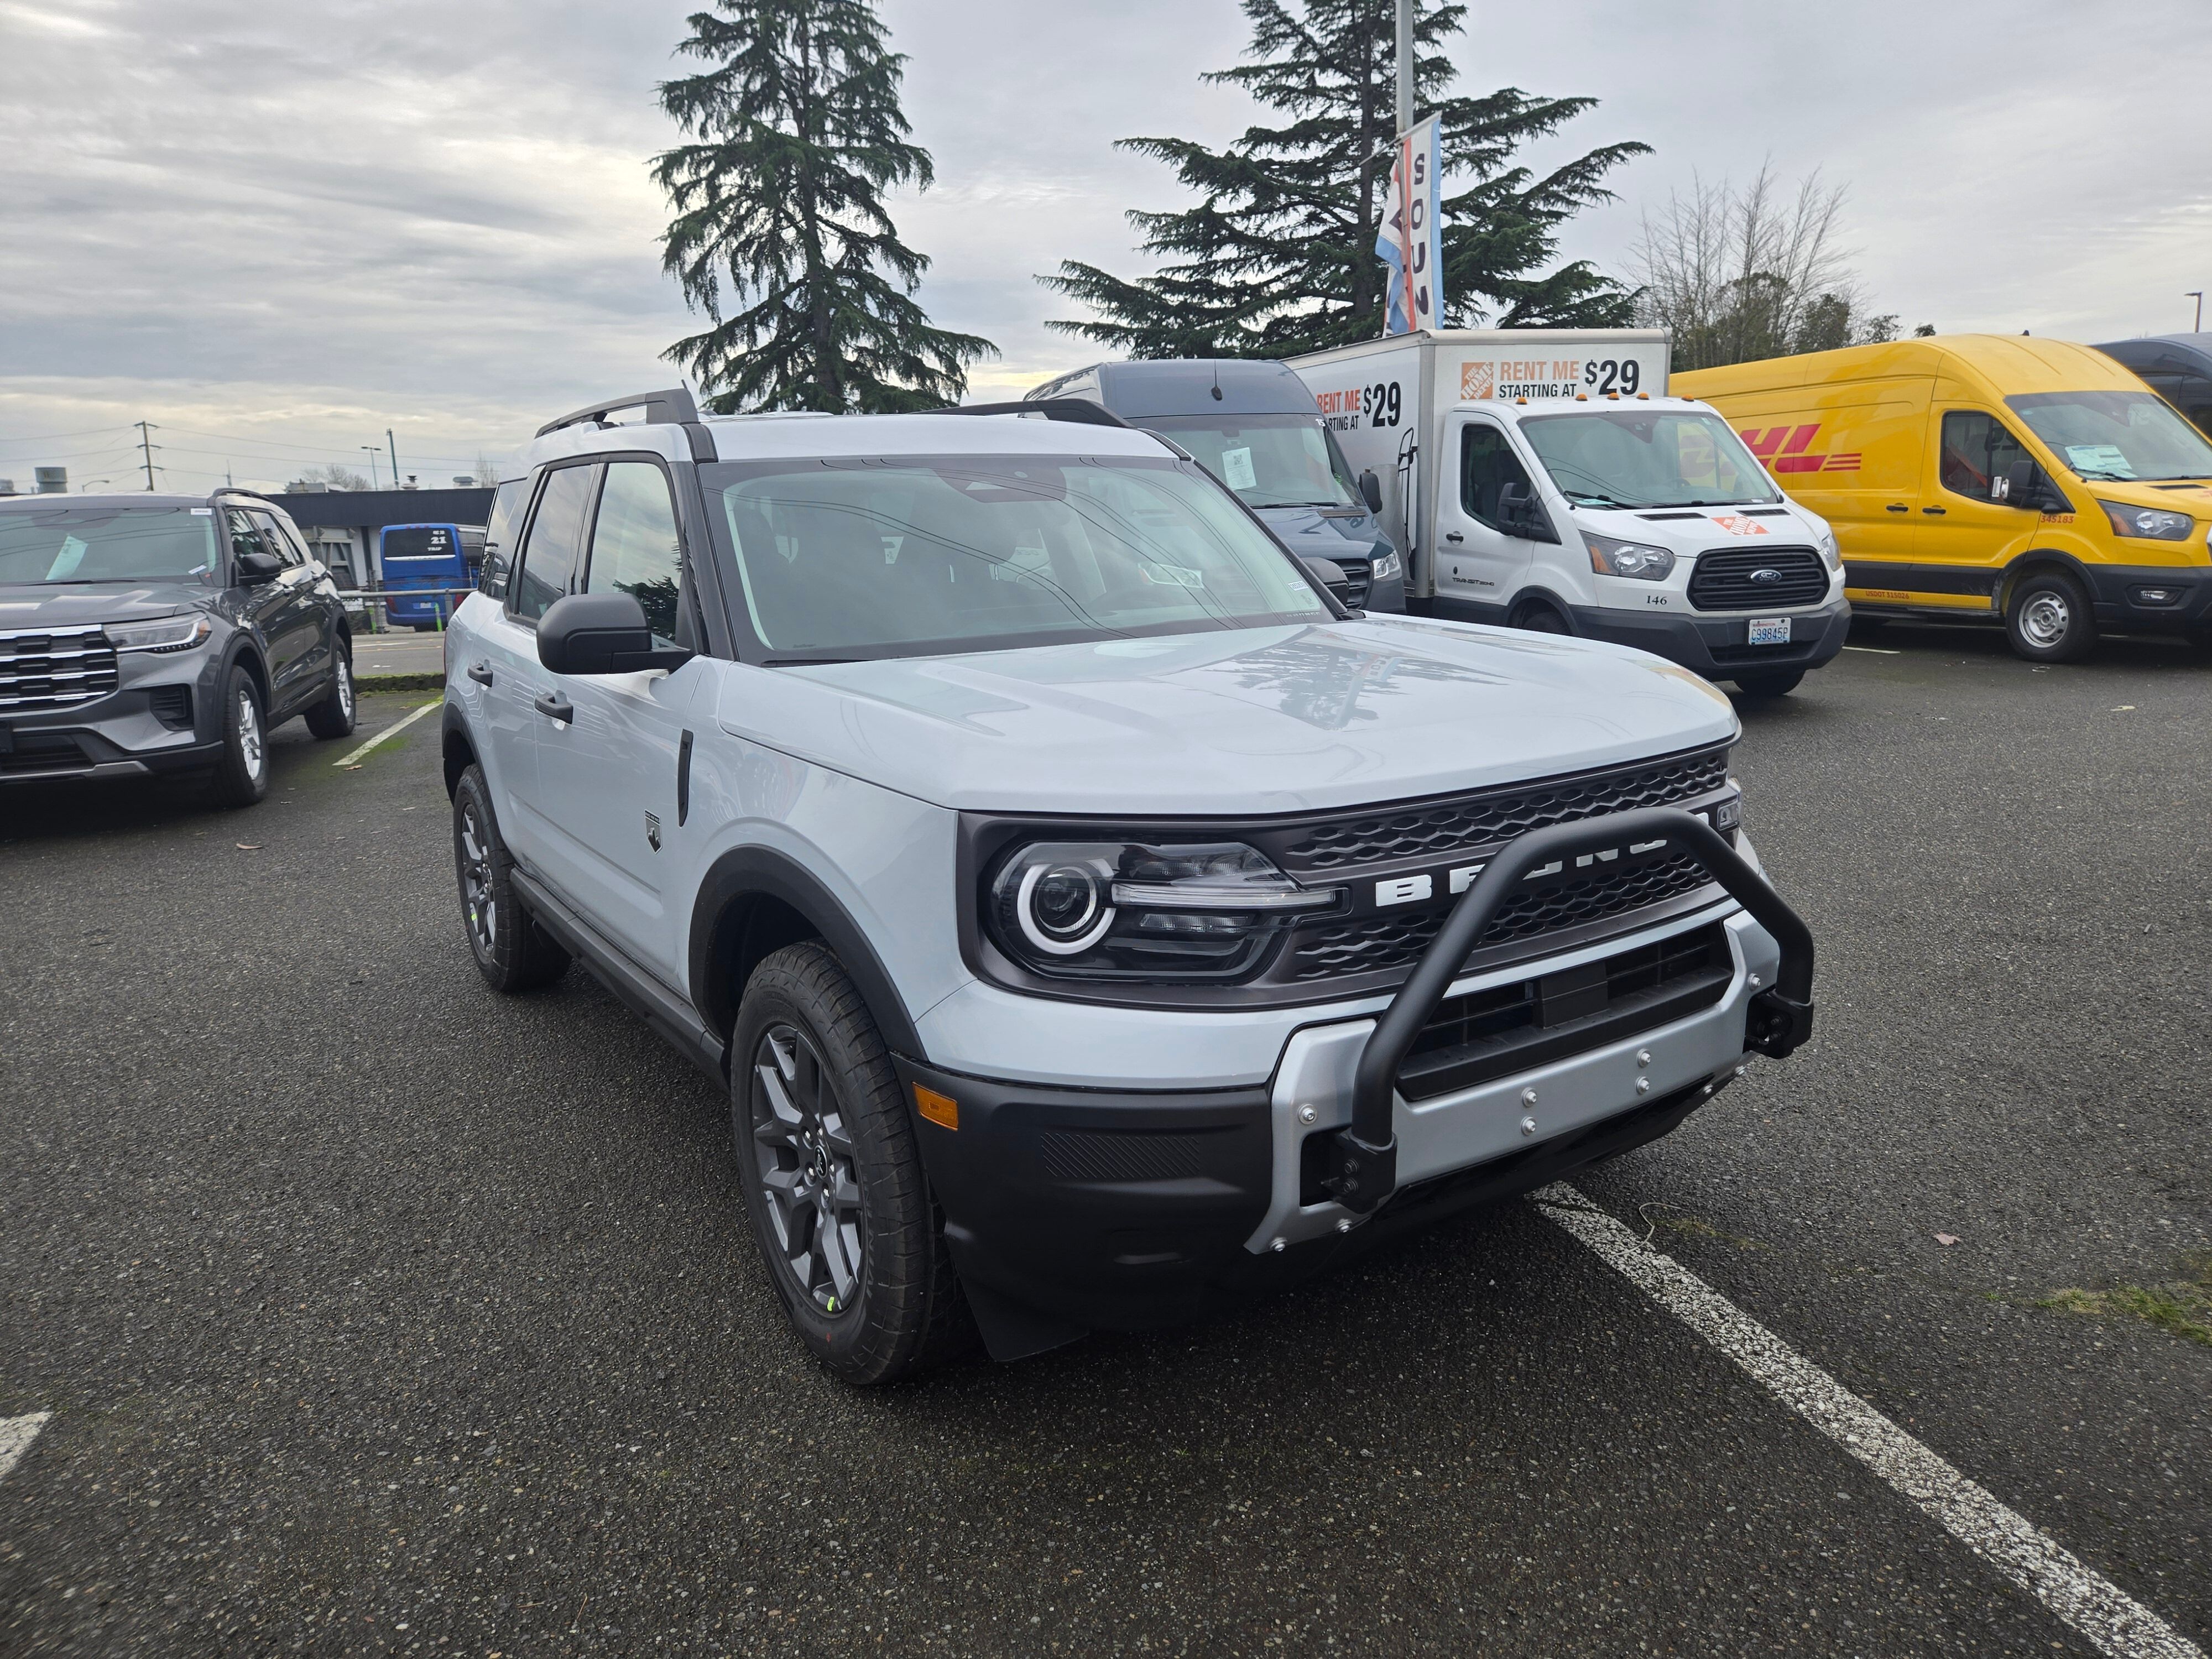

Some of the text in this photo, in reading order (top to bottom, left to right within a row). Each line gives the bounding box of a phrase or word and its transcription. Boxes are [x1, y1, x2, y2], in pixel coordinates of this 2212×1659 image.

[1464, 366, 1479, 380] THE
[1500, 361, 1579, 380] RENT ME
[1585, 359, 1640, 395] $29
[1461, 362, 1494, 399] HOME
[1473, 375, 1494, 399] DEPOT
[1499, 383, 1577, 398] STARTING AT
[1317, 389, 1360, 414] RENT ME
[1363, 381, 1401, 427] $29
[1328, 415, 1359, 431] RTING AT
[2041, 515, 2074, 524] 345183
[431, 536, 447, 544] 21
[1646, 595, 1667, 606] 146
[1751, 627, 1788, 640] C99845P
